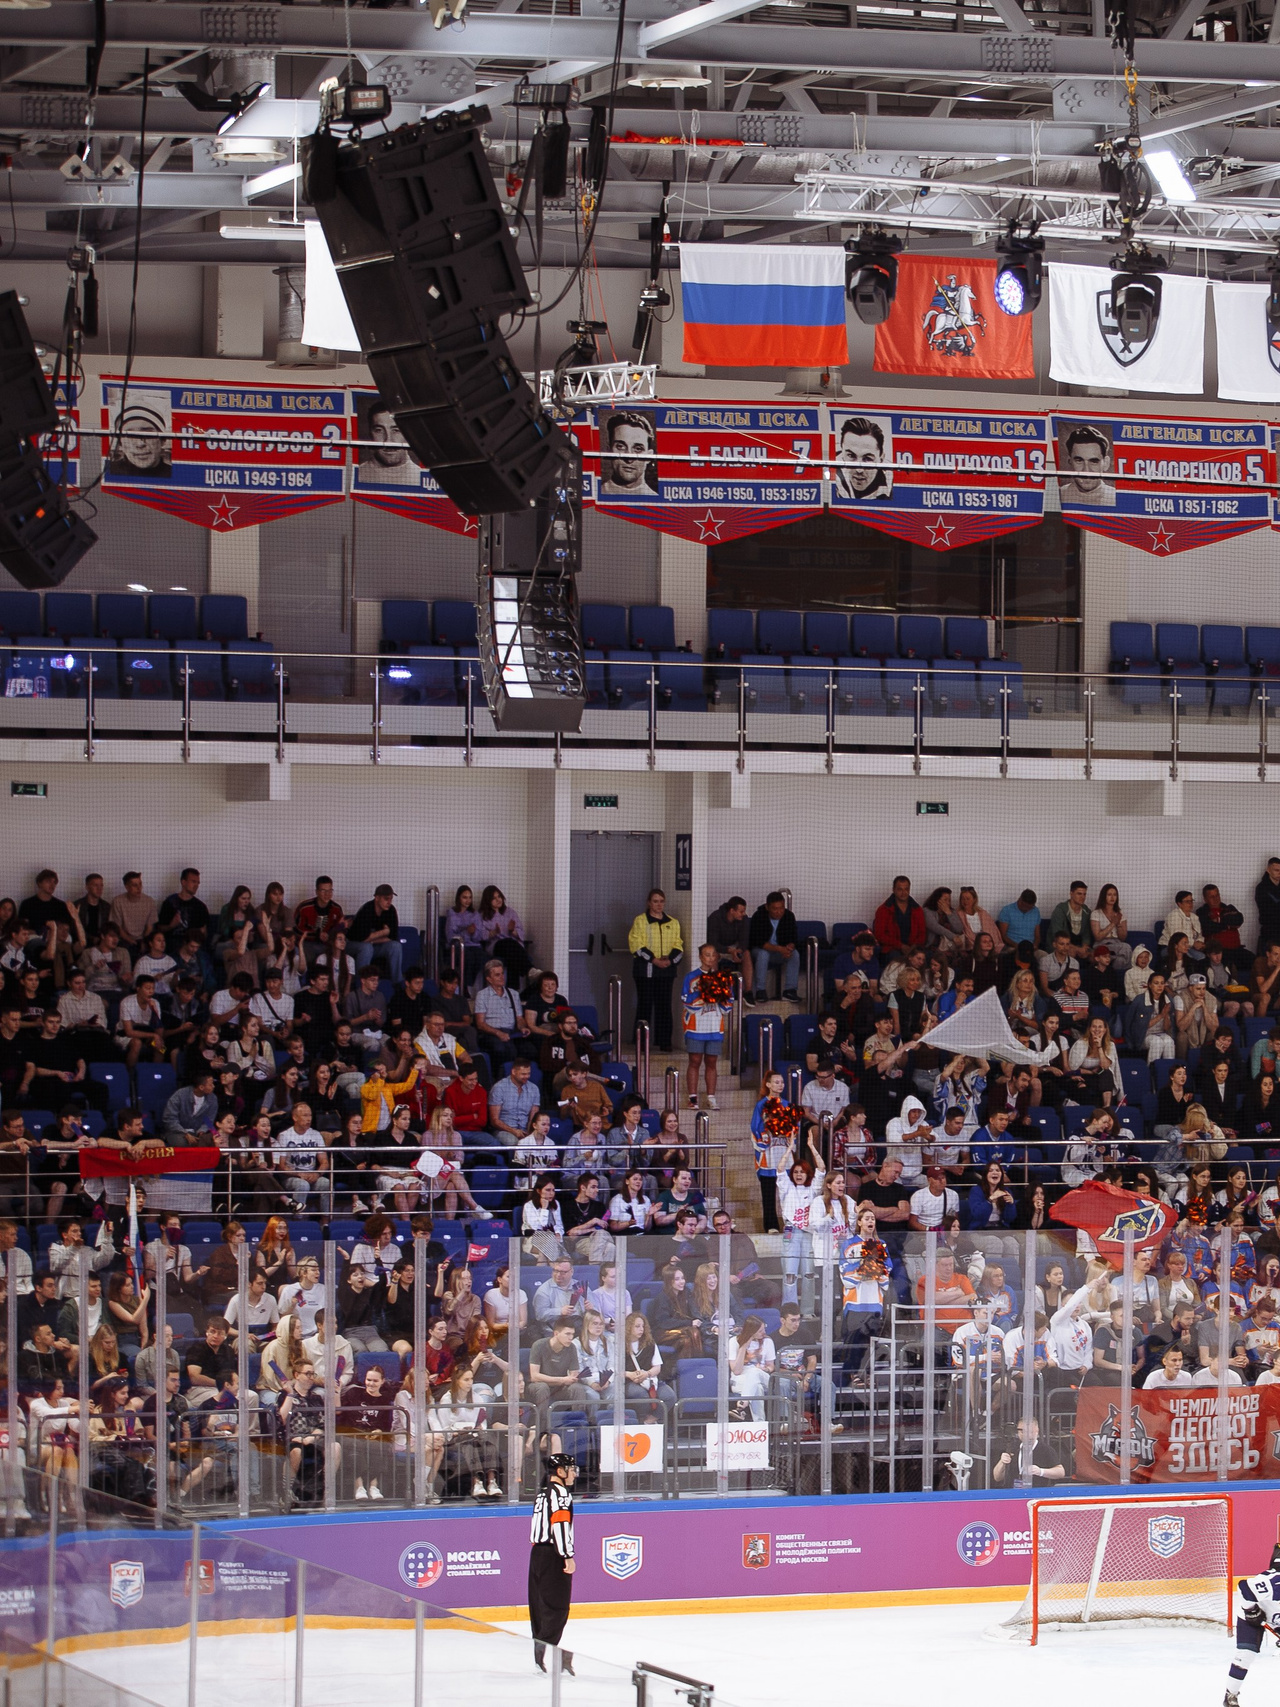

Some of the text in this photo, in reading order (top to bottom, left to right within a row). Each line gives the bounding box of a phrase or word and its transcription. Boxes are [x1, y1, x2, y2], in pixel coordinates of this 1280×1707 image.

[358, 101, 378, 109] RISE
[180, 390, 334, 411] ЛЕГЕНДЫ ЦСКА
[664, 410, 810, 428] ЛЕГЕНДЫ ЦСКА
[899, 417, 1037, 436] ЛЕГЕНДЫ ЦСКА
[321, 423, 342, 460] 2
[1120, 424, 1257, 443] ЛЕГЕНДЫ ЦСКА
[791, 440, 811, 475] 7
[923, 452, 1014, 473] ПАНТЮХОВ
[1014, 449, 1046, 483] 13
[1134, 458, 1243, 483] СИДОРЕНКОВ
[1245, 453, 1266, 484] 5
[204, 468, 313, 488] ЦСКА 1949-1964
[663, 485, 818, 502] ЦСКА 1946-1950, 1953-1957
[922, 491, 1018, 508] ЦСКА 1953-1961
[1144, 497, 1239, 514] ЦСКА 1951-1962
[677, 839, 690, 869] 11
[1169, 1393, 1260, 1417] ЧЕМПИОНОВ
[713, 1429, 767, 1446] ОМОВ
[626, 1441, 638, 1458] 7
[710, 1451, 761, 1461] FREVER
[1168, 1438, 1260, 1474] ЗДЕСЬ
[775, 1533, 806, 1541] КОМИТЕТ
[775, 1538, 853, 1549] ОБЩЕСТВЕННЫХ СВЯЗЕЙ
[1003, 1531, 1054, 1542] МОСВА
[608, 1540, 638, 1551] МСХЛ
[781, 1548, 827, 1557] МОЛОДЁЖНОЙ
[828, 1547, 862, 1555] ПОЛИТИКИ
[446, 1550, 501, 1562] МОСКВА
[775, 1557, 801, 1565] ГОРОДА
[1254, 1580, 1269, 1595] 27
